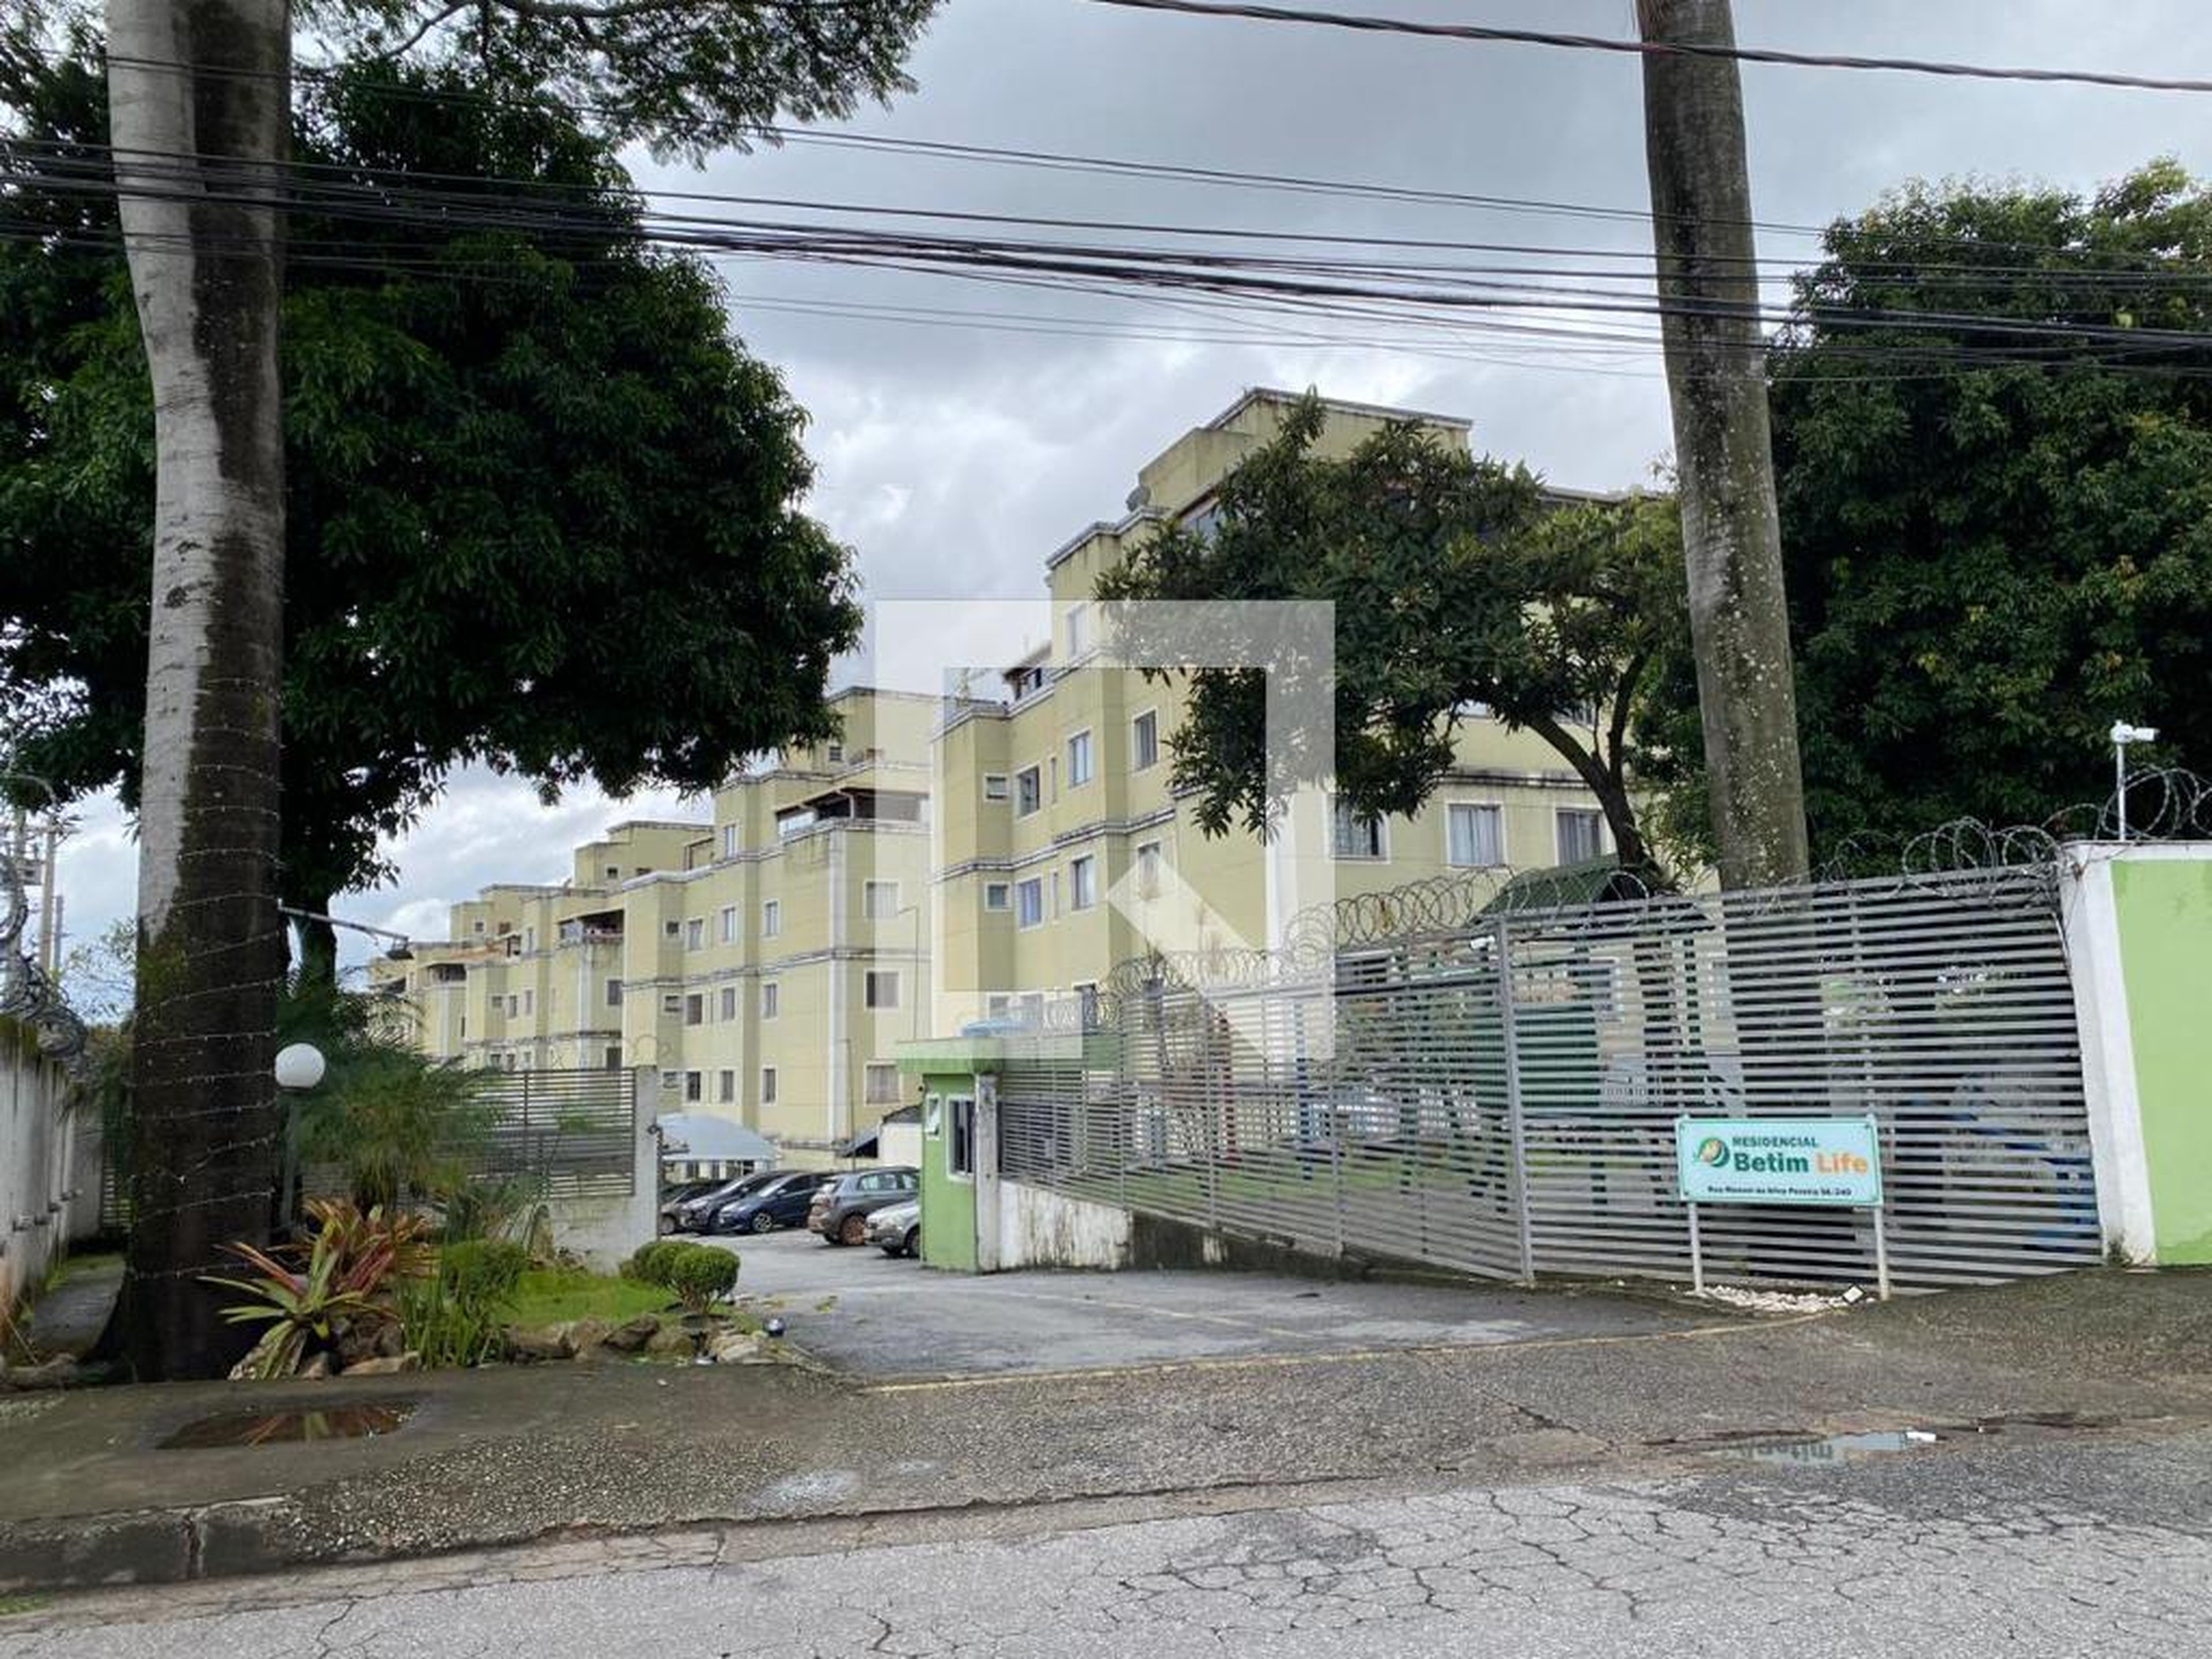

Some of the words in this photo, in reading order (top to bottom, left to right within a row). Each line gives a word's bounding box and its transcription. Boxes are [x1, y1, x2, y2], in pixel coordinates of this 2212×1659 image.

[1732, 1137, 1819, 1147] RESIDENCIAL
[1734, 1153, 1809, 1172] Betim
[1816, 1153, 1868, 1174] Life
